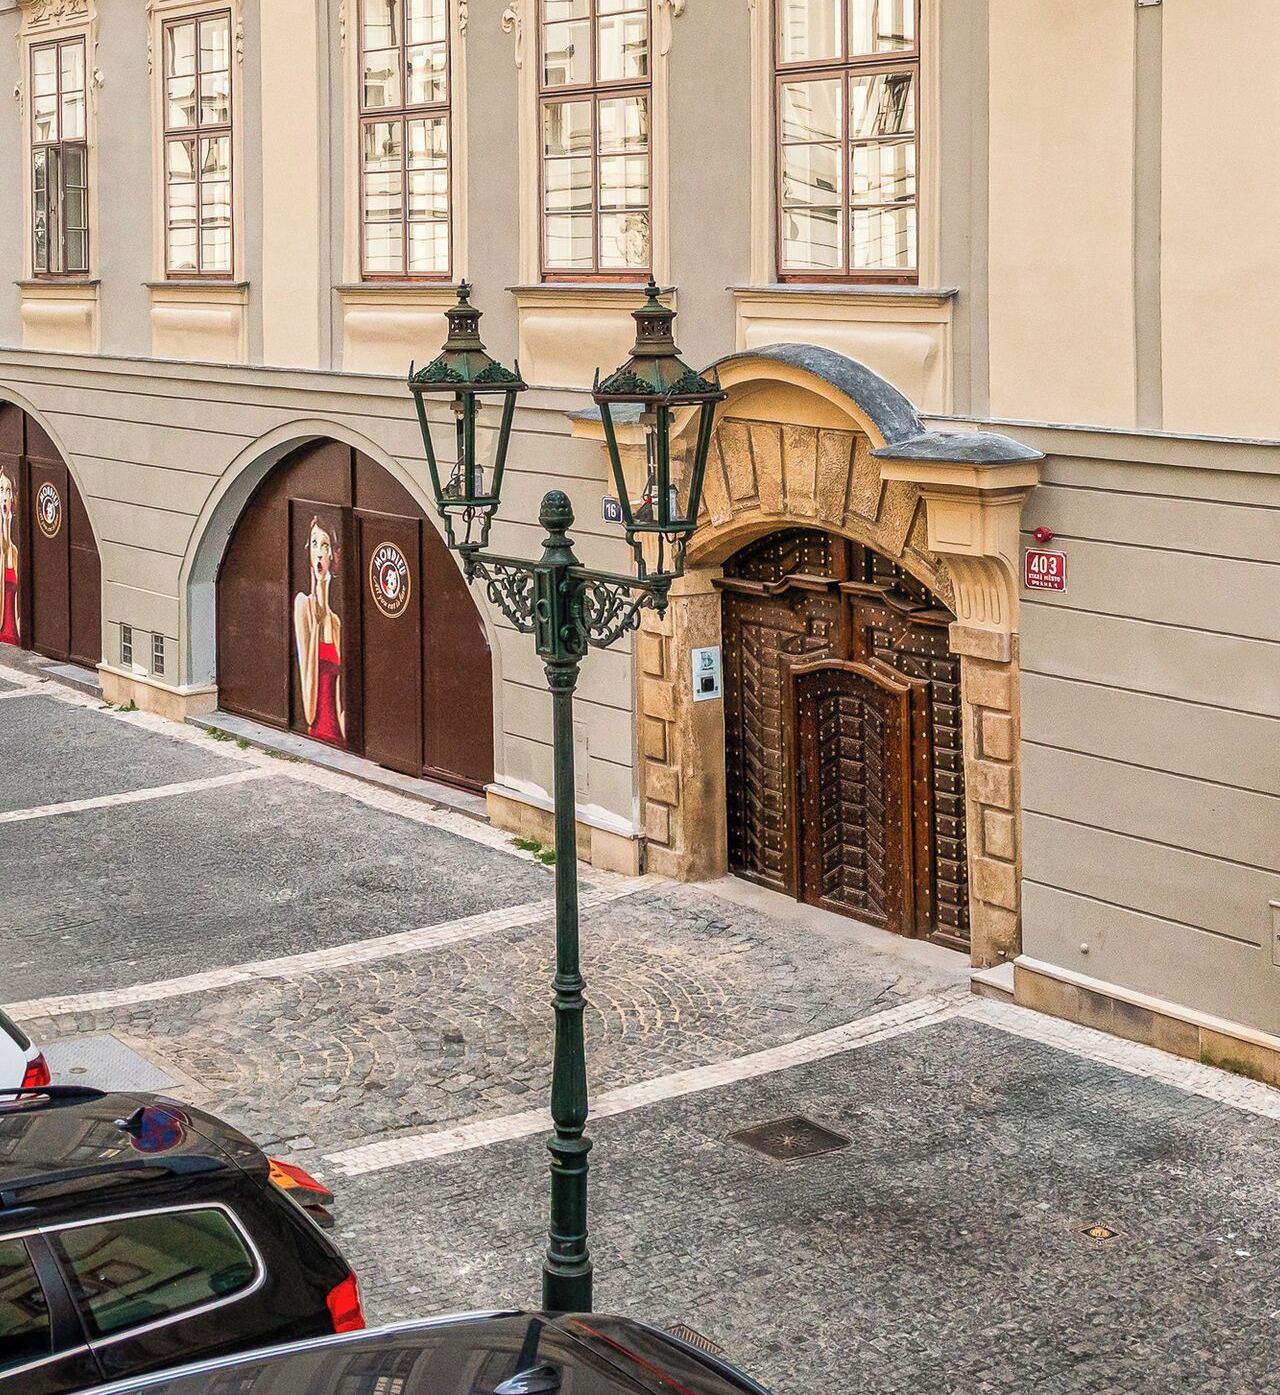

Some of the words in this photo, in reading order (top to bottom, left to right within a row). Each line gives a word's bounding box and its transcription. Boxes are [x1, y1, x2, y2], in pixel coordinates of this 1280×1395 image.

[606, 504, 616, 518] 16
[374, 548, 406, 575] MONDIEU
[1031, 555, 1057, 574] 403
